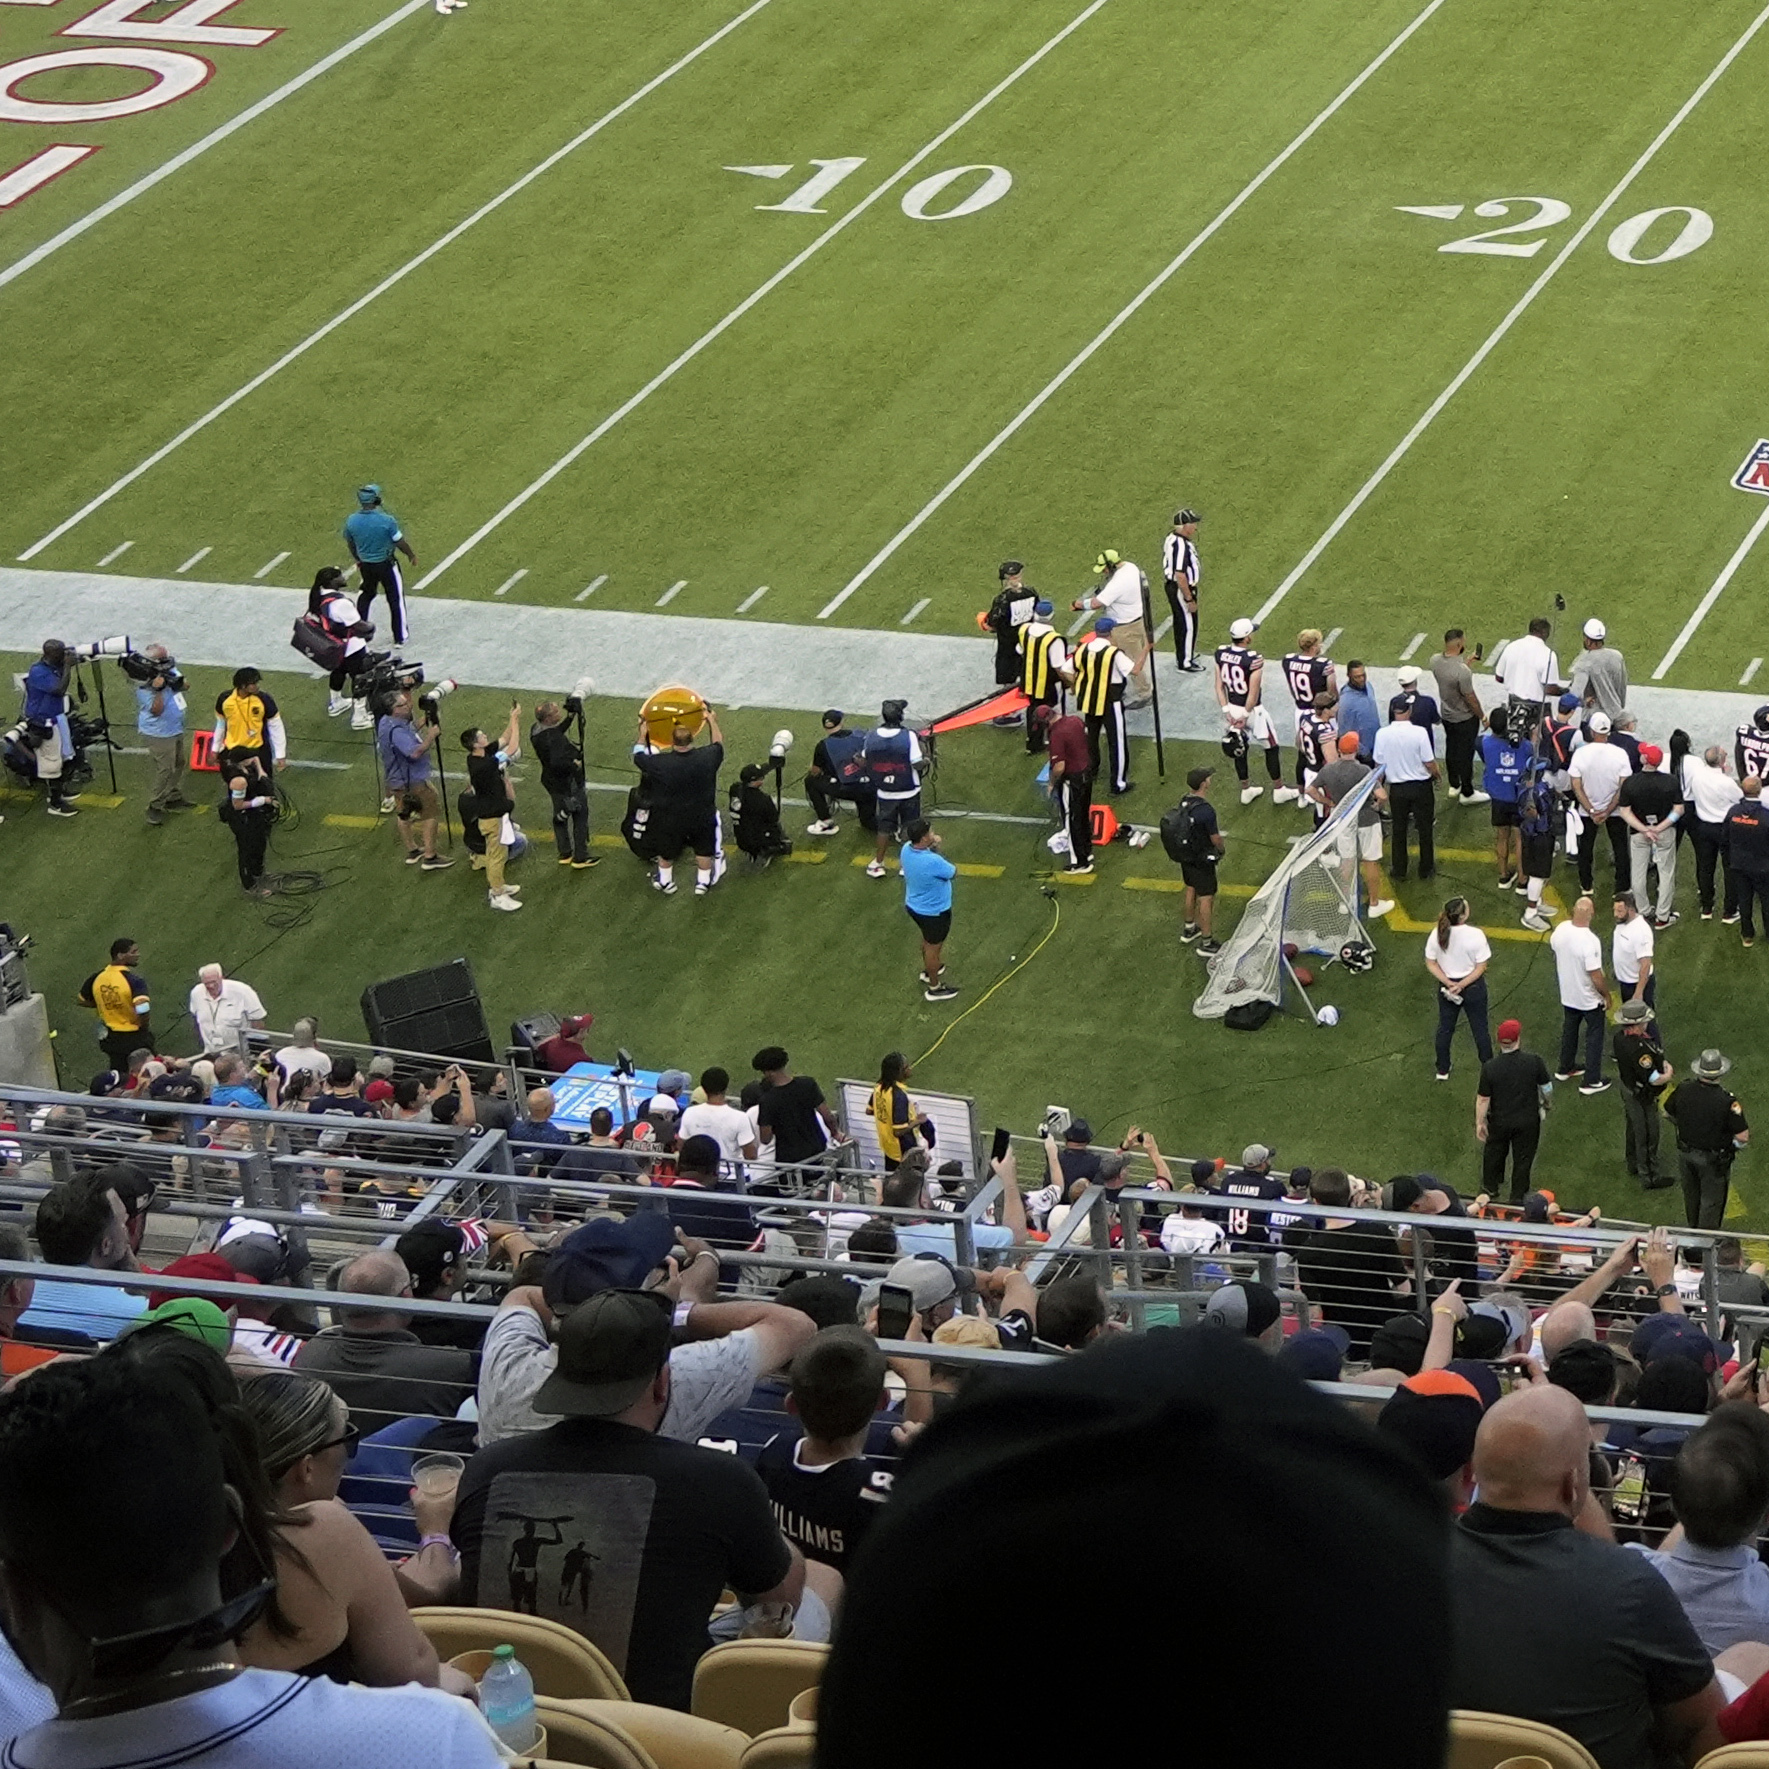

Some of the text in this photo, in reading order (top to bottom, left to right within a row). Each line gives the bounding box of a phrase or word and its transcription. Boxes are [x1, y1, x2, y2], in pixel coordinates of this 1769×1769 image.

[1220, 665, 1248, 694] 48
[1290, 672, 1314, 702] 19
[1228, 1184, 1260, 1197] WILLIAMS
[1228, 1208, 1249, 1234] 18
[769, 1499, 844, 1553] ILLIAMS
